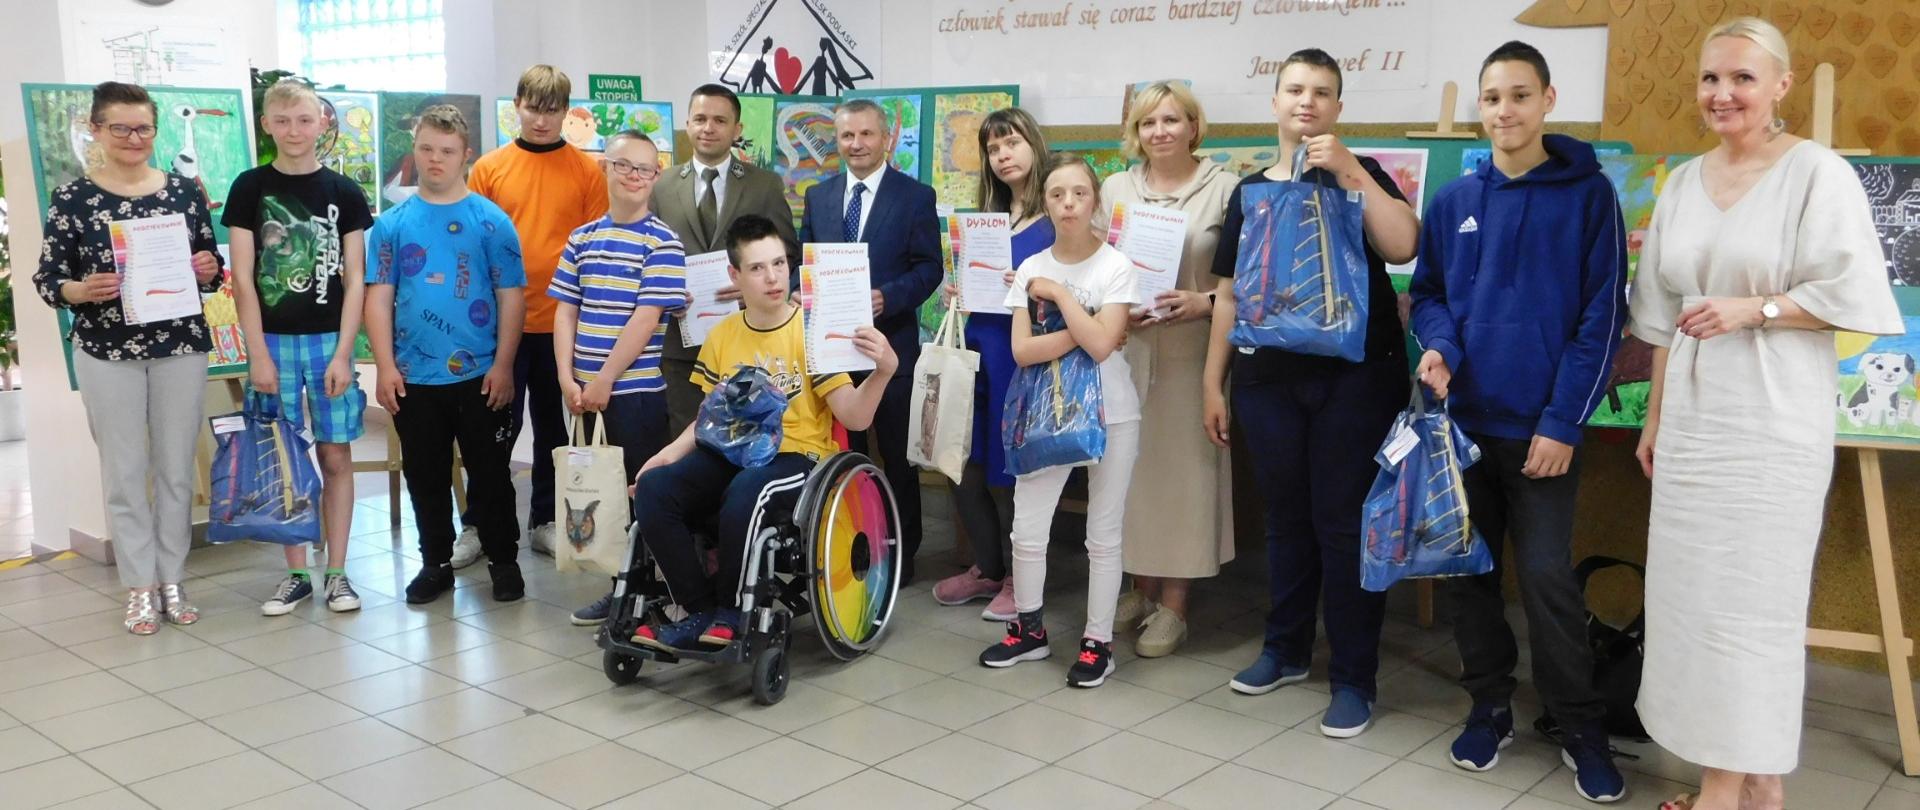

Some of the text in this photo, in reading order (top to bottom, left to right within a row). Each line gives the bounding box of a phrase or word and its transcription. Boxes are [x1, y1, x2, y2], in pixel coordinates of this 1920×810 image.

[938, 7, 1008, 35] człowiek
[1013, 3, 1072, 29] stawał
[1078, 3, 1101, 31] się
[1110, 5, 1156, 24] coraz
[1168, 0, 1242, 25] bardziej
[827, 12, 857, 51] PODLASKI
[1380, 51, 1405, 71] II
[596, 79, 635, 89] UWAGA
[966, 217, 1006, 229] DYPLOM
[310, 215, 329, 304] LANTERN
